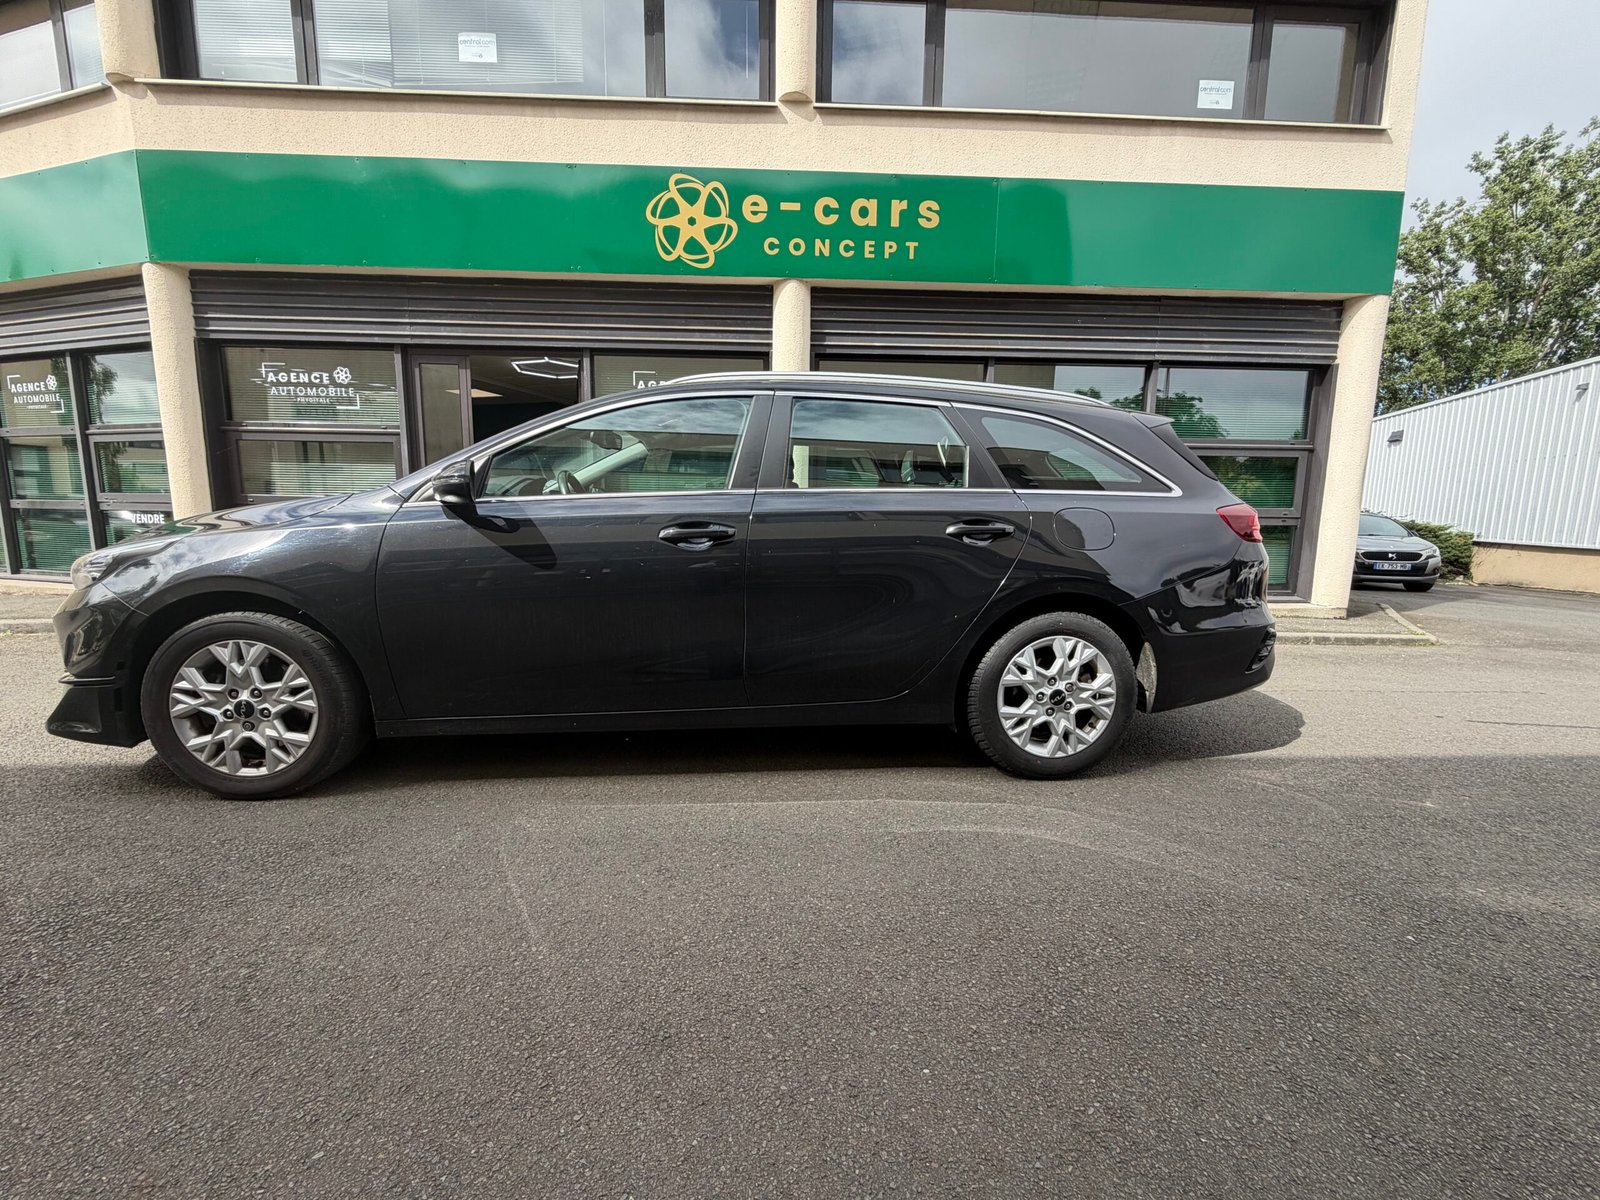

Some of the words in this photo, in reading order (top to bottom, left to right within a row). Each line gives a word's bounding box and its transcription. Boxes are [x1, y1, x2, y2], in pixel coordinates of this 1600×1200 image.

[742, 194, 940, 229] e-cars
[763, 237, 918, 260] CONCEPT
[267, 372, 330, 384] AGENCE
[11, 381, 46, 393] AGENCE
[270, 386, 354, 397] AUTOMOBILE
[14, 393, 60, 404] AUTOMOBILE
